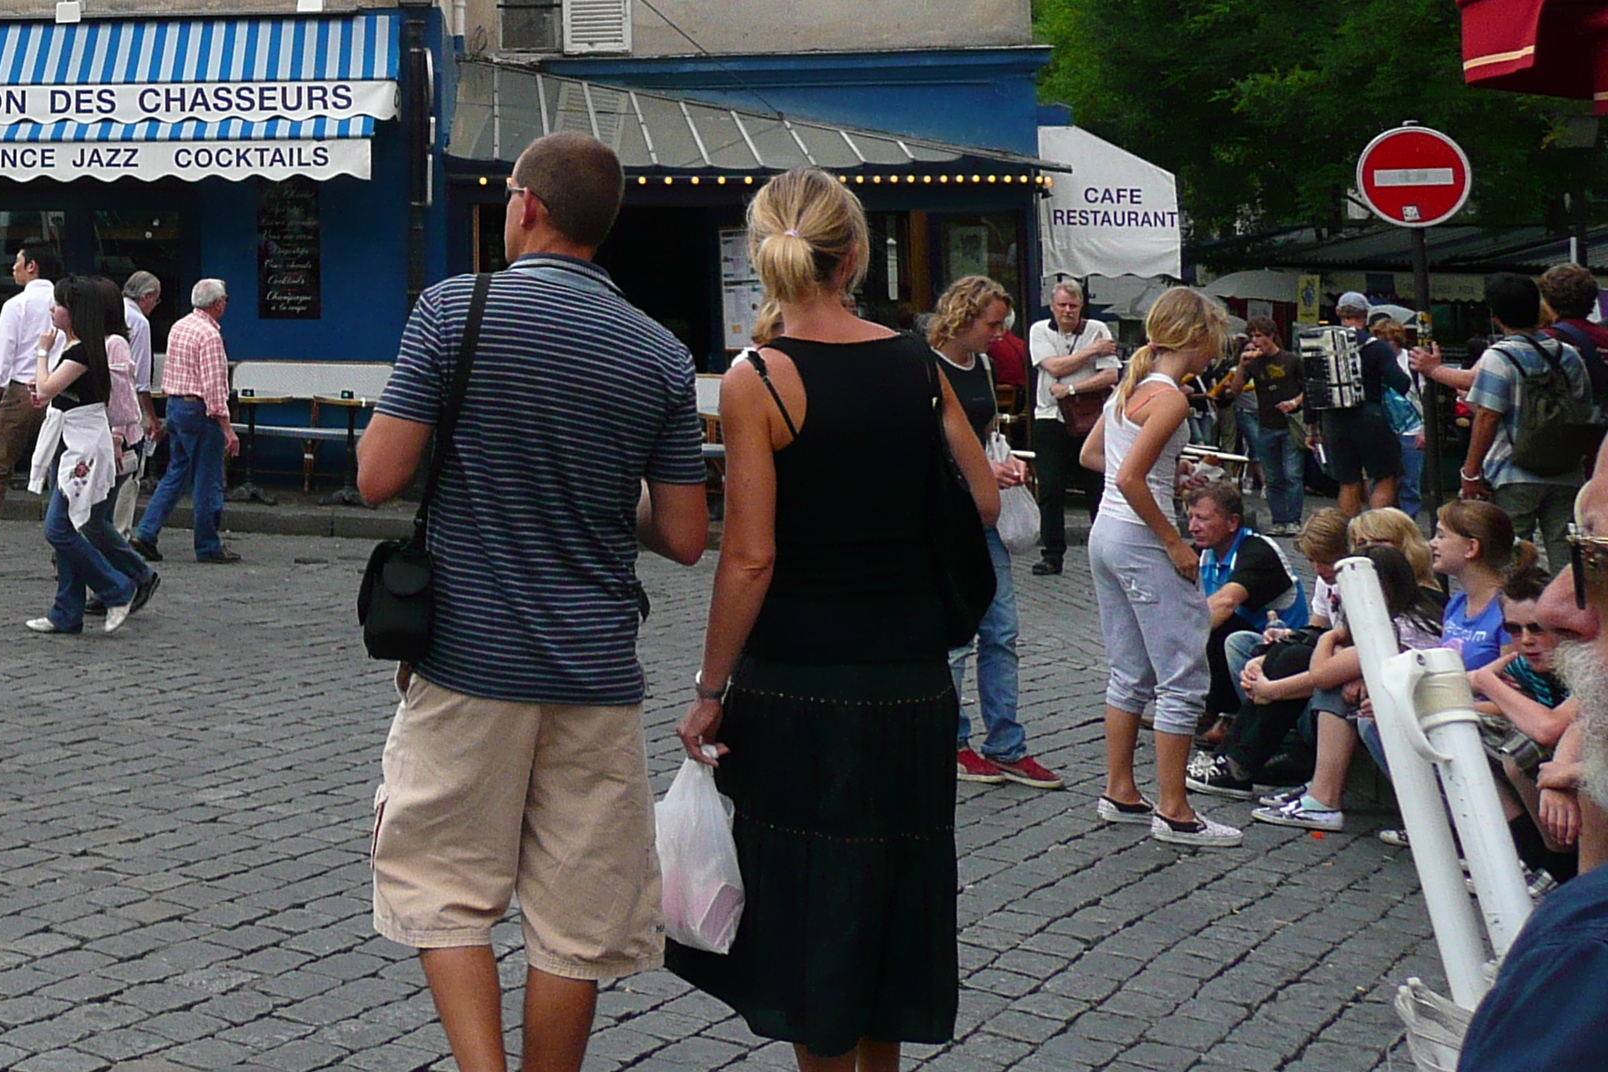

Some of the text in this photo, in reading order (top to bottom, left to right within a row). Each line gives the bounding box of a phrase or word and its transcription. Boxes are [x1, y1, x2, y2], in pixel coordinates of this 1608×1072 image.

[50, 88, 117, 114] DES
[138, 84, 353, 113] CHASSEURS
[72, 148, 140, 168] JAZZ
[174, 146, 330, 168] COCKTAILS
[1084, 187, 1143, 205] CAFE
[1053, 209, 1178, 228] RESTAURANT
